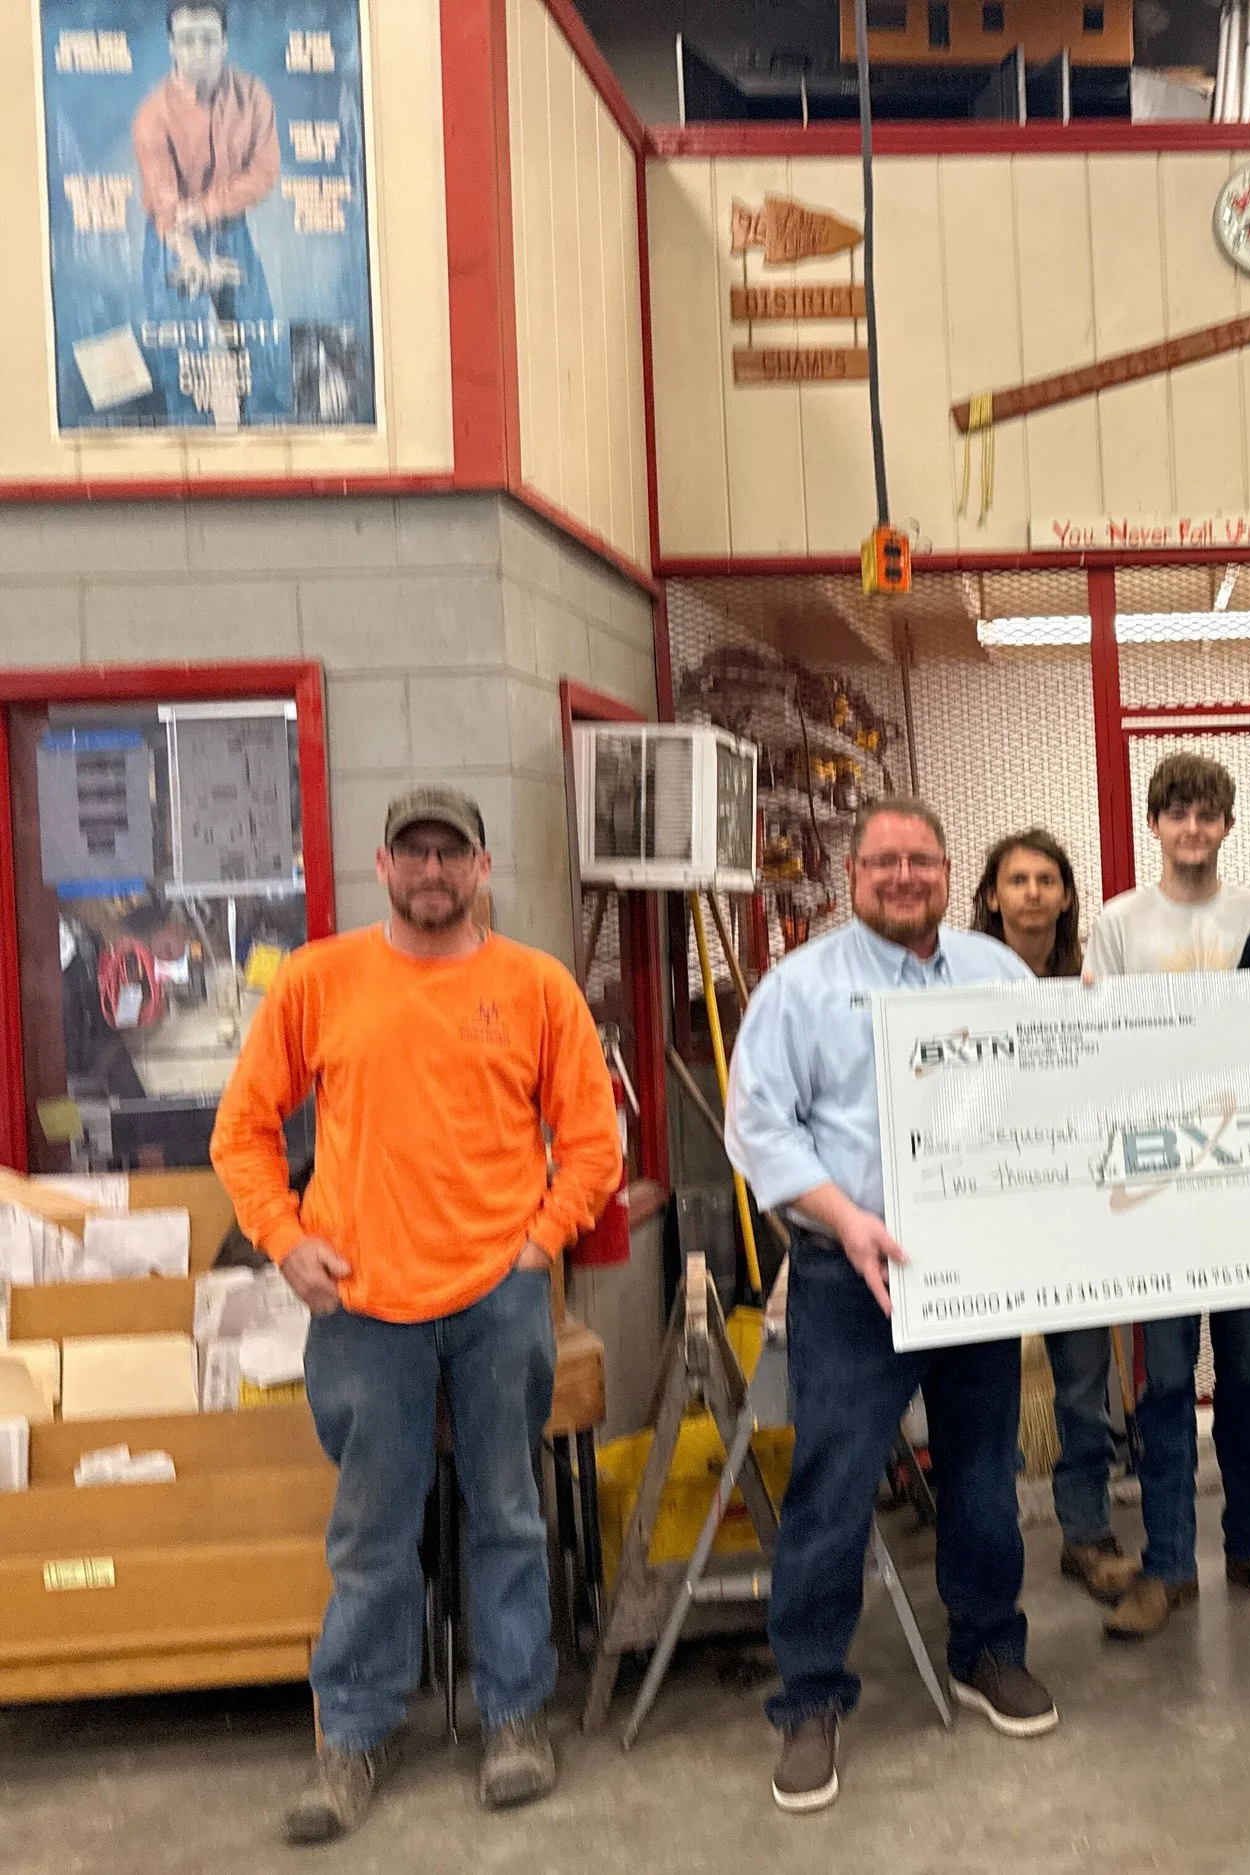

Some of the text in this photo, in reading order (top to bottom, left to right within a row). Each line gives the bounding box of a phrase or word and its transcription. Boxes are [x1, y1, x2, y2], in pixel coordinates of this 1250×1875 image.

[762, 350, 846, 379] CHAMPS
[1052, 518, 1096, 548] You
[1108, 518, 1171, 547] Never
